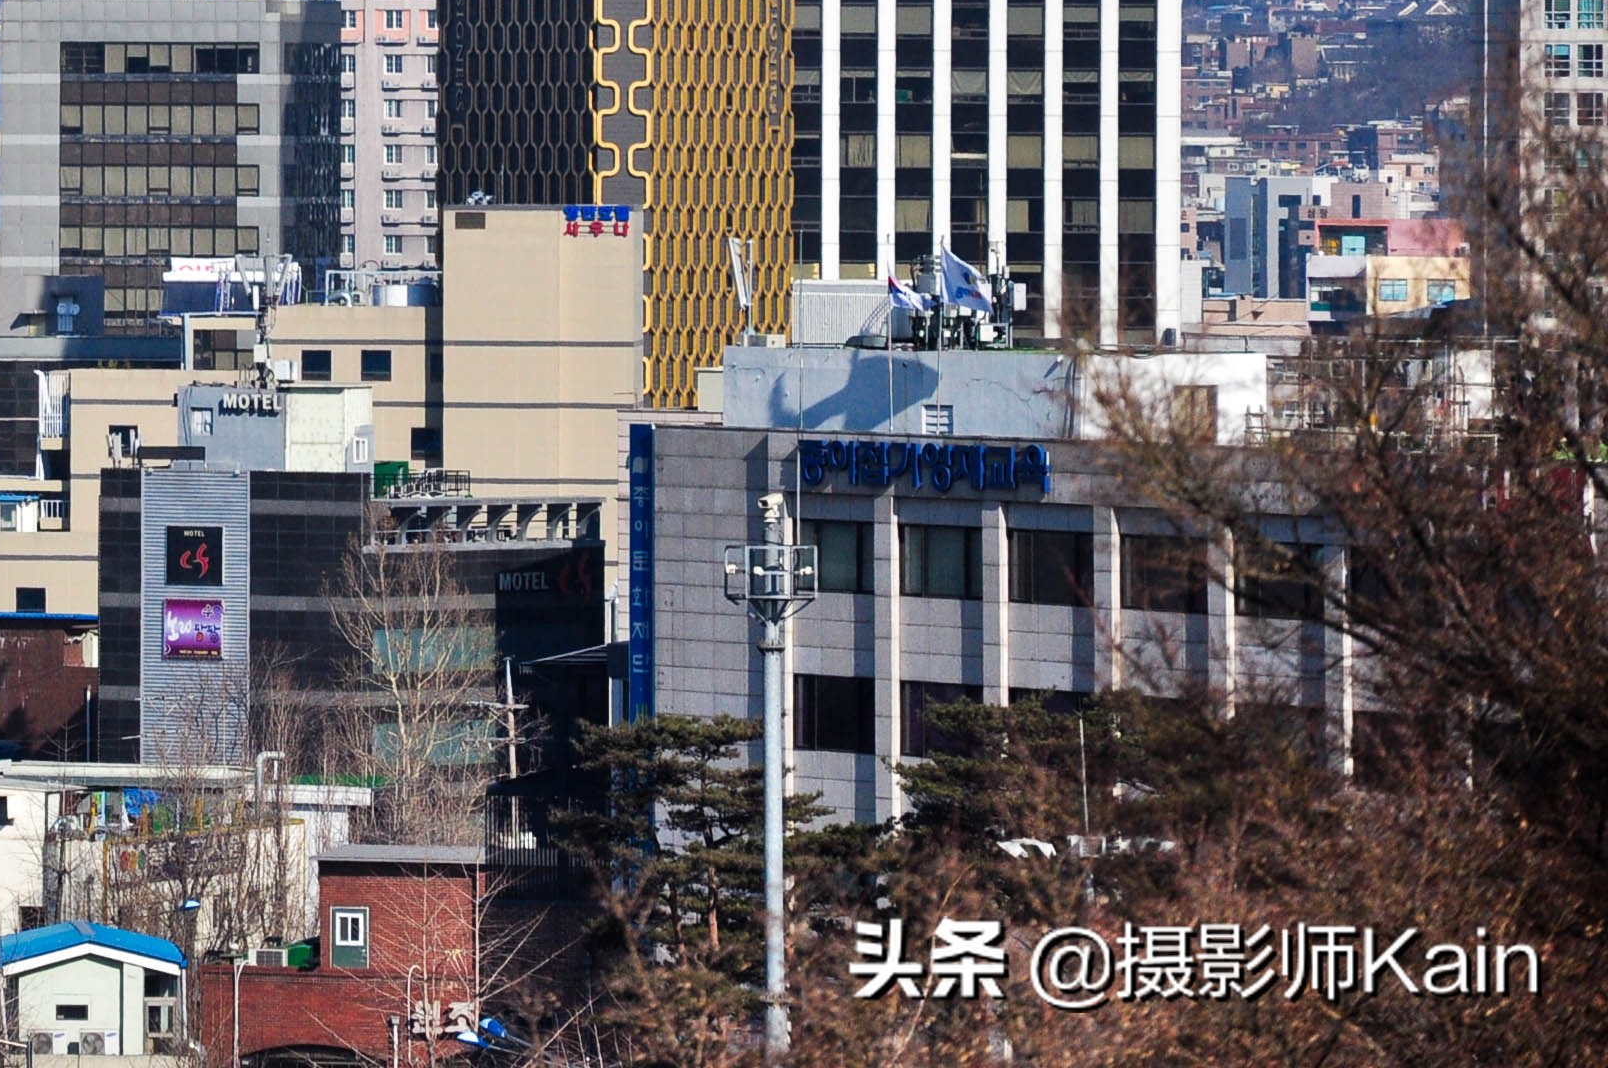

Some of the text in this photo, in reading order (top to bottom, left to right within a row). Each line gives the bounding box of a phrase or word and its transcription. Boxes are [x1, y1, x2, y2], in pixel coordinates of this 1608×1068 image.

[563, 221, 629, 237] 사우나
[222, 393, 283, 411] MOTEL
[498, 572, 550, 591] MOTEL
